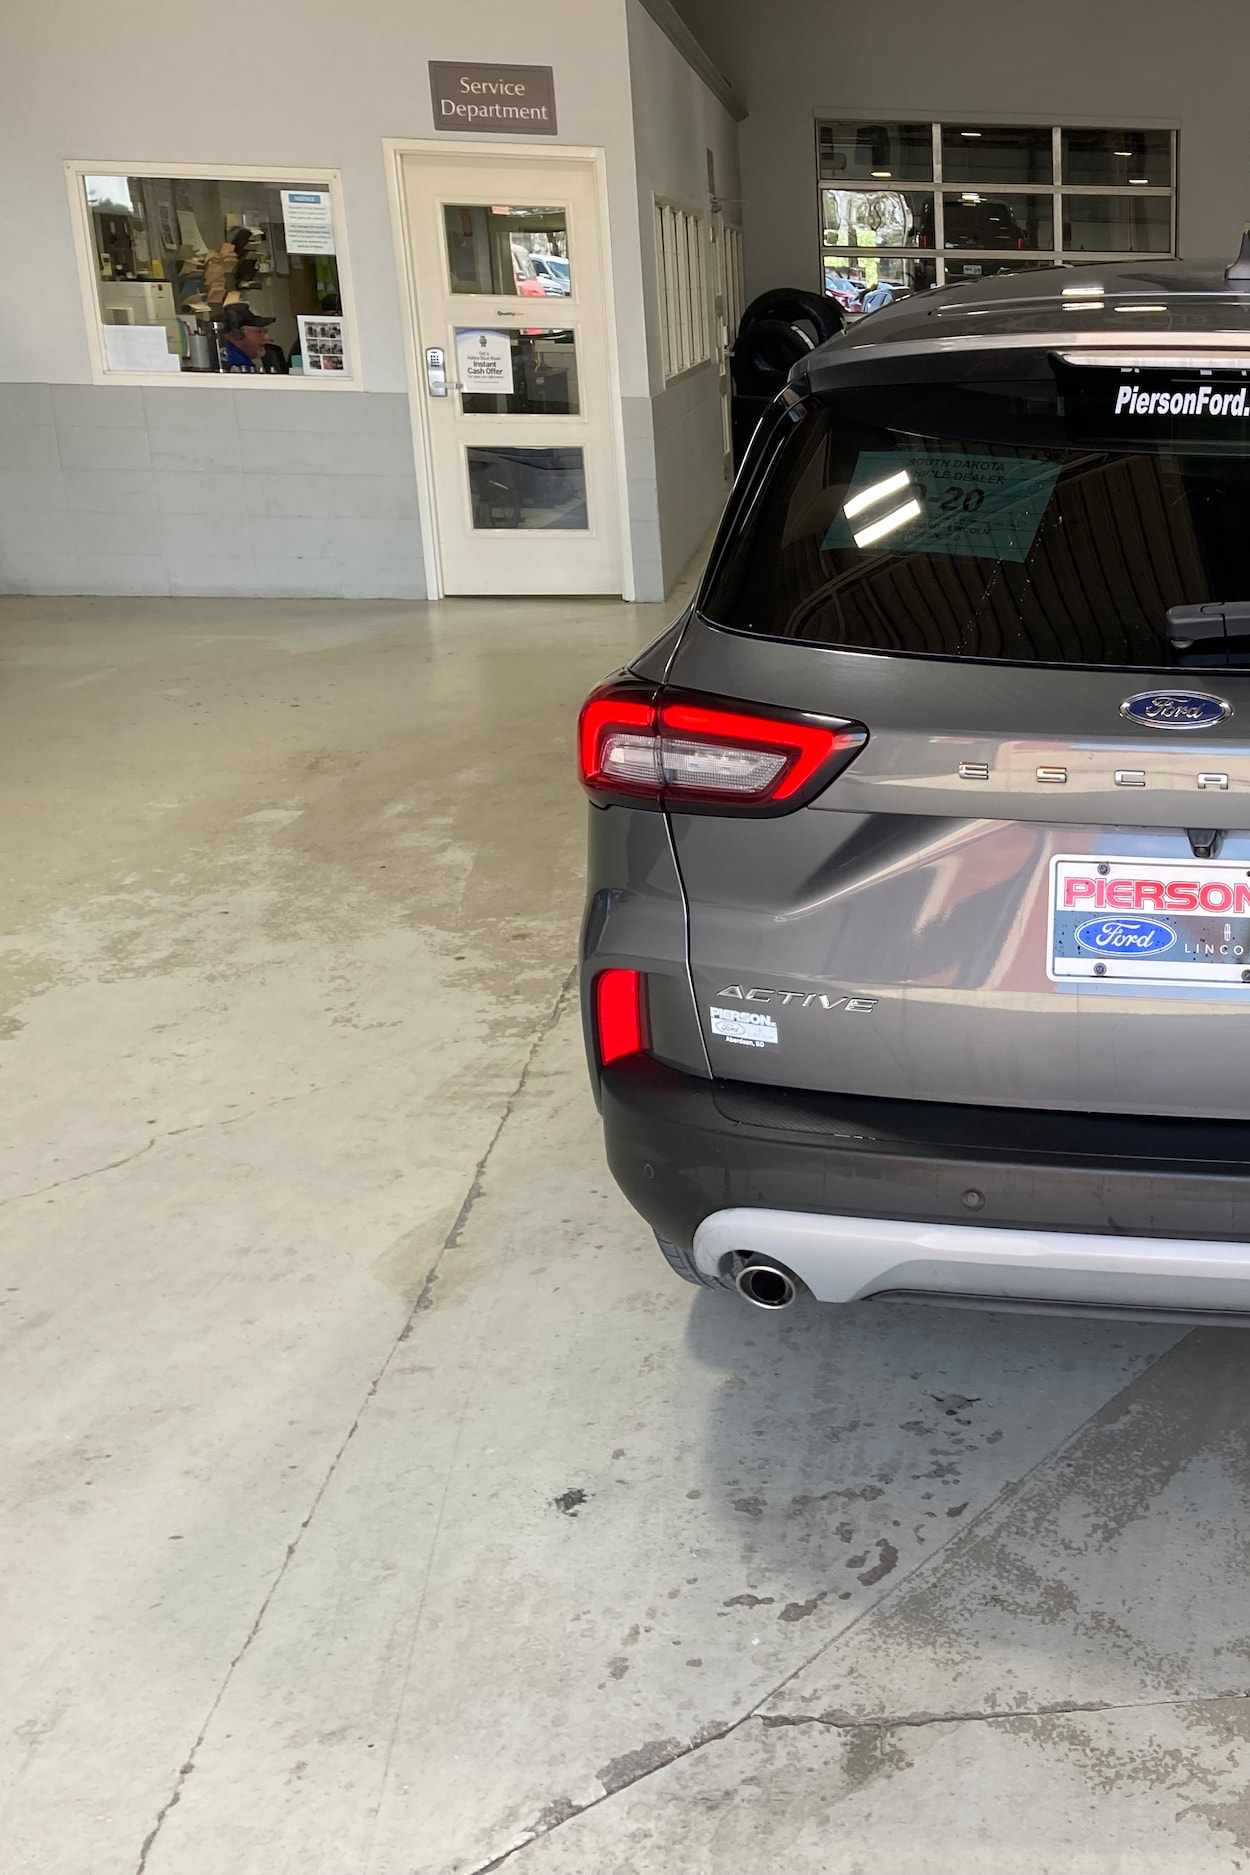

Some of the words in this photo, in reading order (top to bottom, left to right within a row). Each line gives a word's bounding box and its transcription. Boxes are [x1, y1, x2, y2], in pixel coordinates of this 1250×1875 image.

[460, 76, 525, 96] Service
[441, 99, 549, 122] Department
[467, 367, 485, 375] Cash
[485, 367, 504, 375] Offer
[473, 360, 497, 368] Instant
[908, 458, 951, 468] SOUTH
[953, 459, 1006, 472] DAKOTA
[953, 472, 1007, 485] DEALER
[1145, 696, 1206, 719] Ford
[1095, 921, 1156, 949] Ford
[716, 984, 879, 1013] ACTIVE
[709, 1006, 771, 1027] PIERSON
